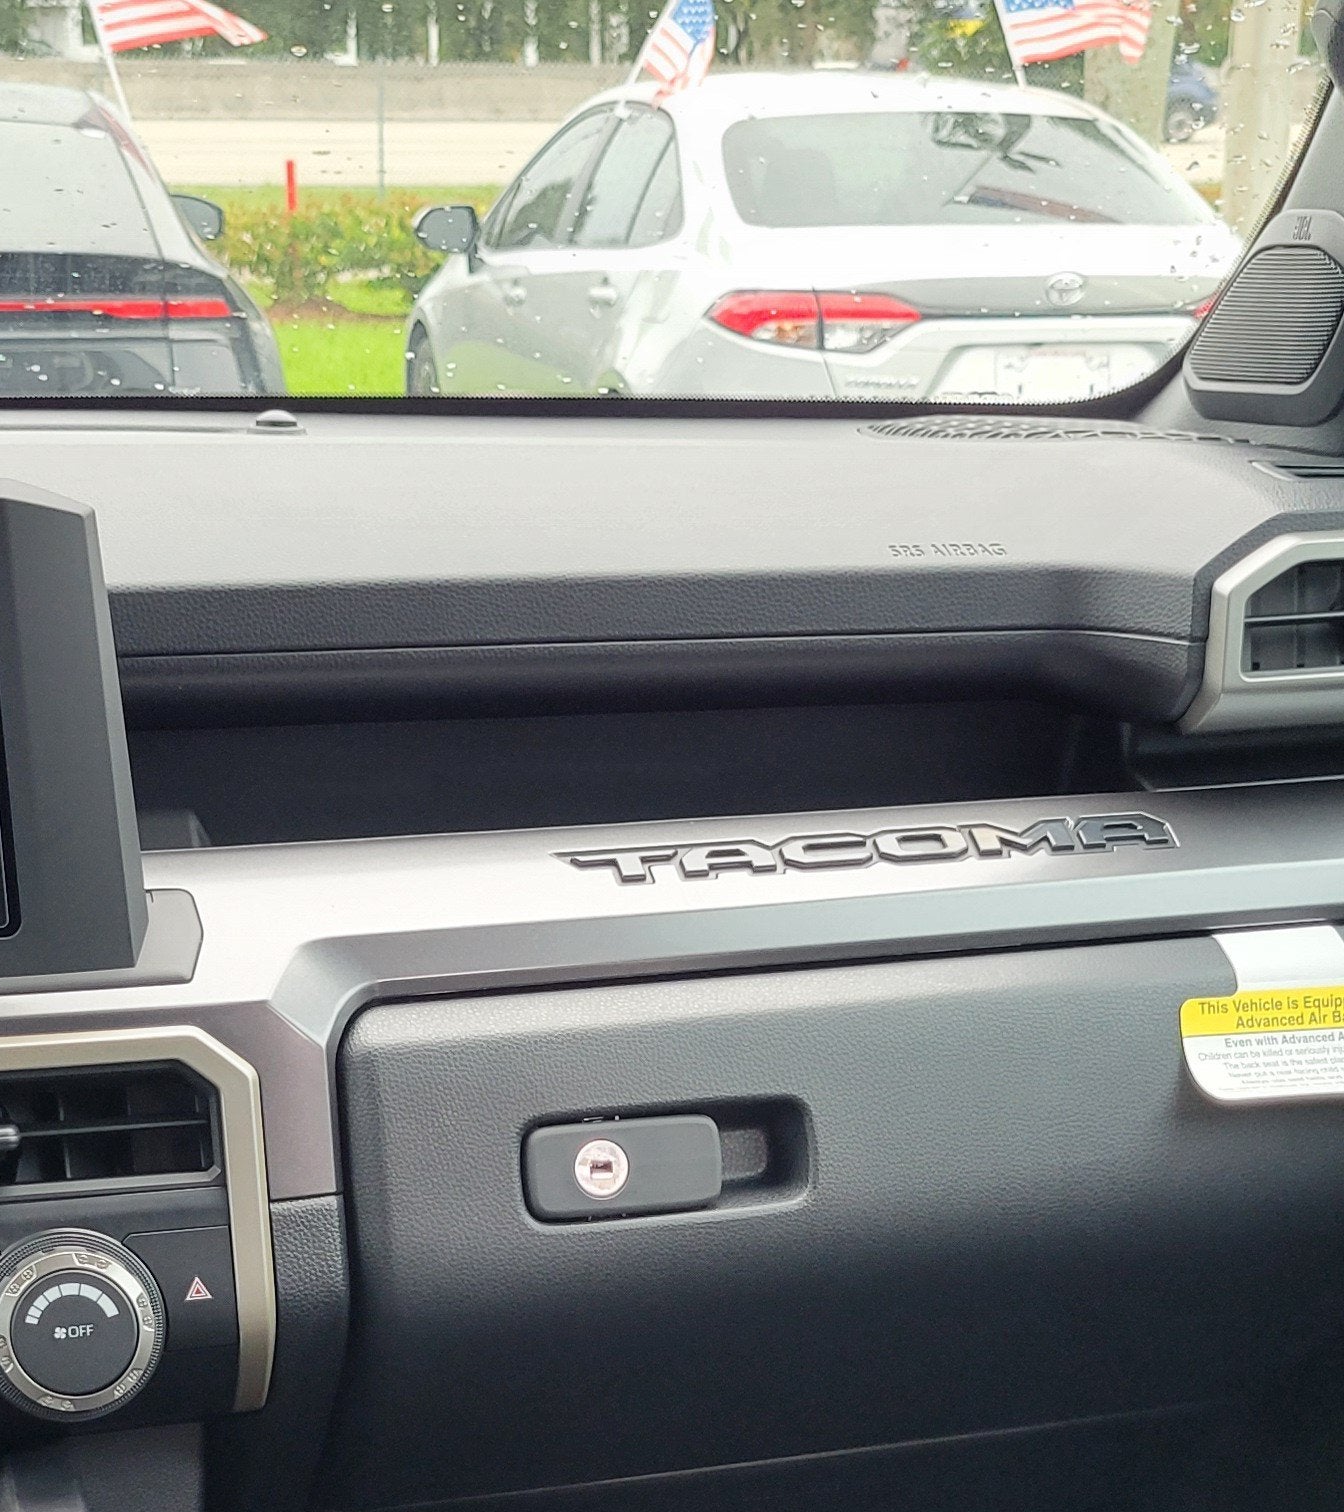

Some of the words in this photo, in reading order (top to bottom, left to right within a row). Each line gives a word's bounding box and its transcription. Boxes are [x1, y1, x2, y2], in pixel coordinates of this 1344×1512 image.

[888, 544, 925, 557] SRS
[931, 543, 1007, 557] AIRBAG
[547, 811, 1181, 886] TACOMA
[1198, 1002, 1230, 1015] This
[1233, 999, 1282, 1013] Vehicle
[1286, 998, 1299, 1010] is
[1236, 1011, 1304, 1029] Advanced
[1308, 1010, 1328, 1024] Air
[1224, 1037, 1253, 1048] Even
[1255, 1034, 1279, 1046] with
[1282, 1031, 1335, 1045] Advanced
[1198, 1050, 1232, 1061] Children
[1250, 1050, 1261, 1058] be
[1263, 1049, 1283, 1057] killed
[1295, 1046, 1330, 1056] seriously
[1224, 1061, 1238, 1070] The
[68, 1324, 94, 1338] OFF
